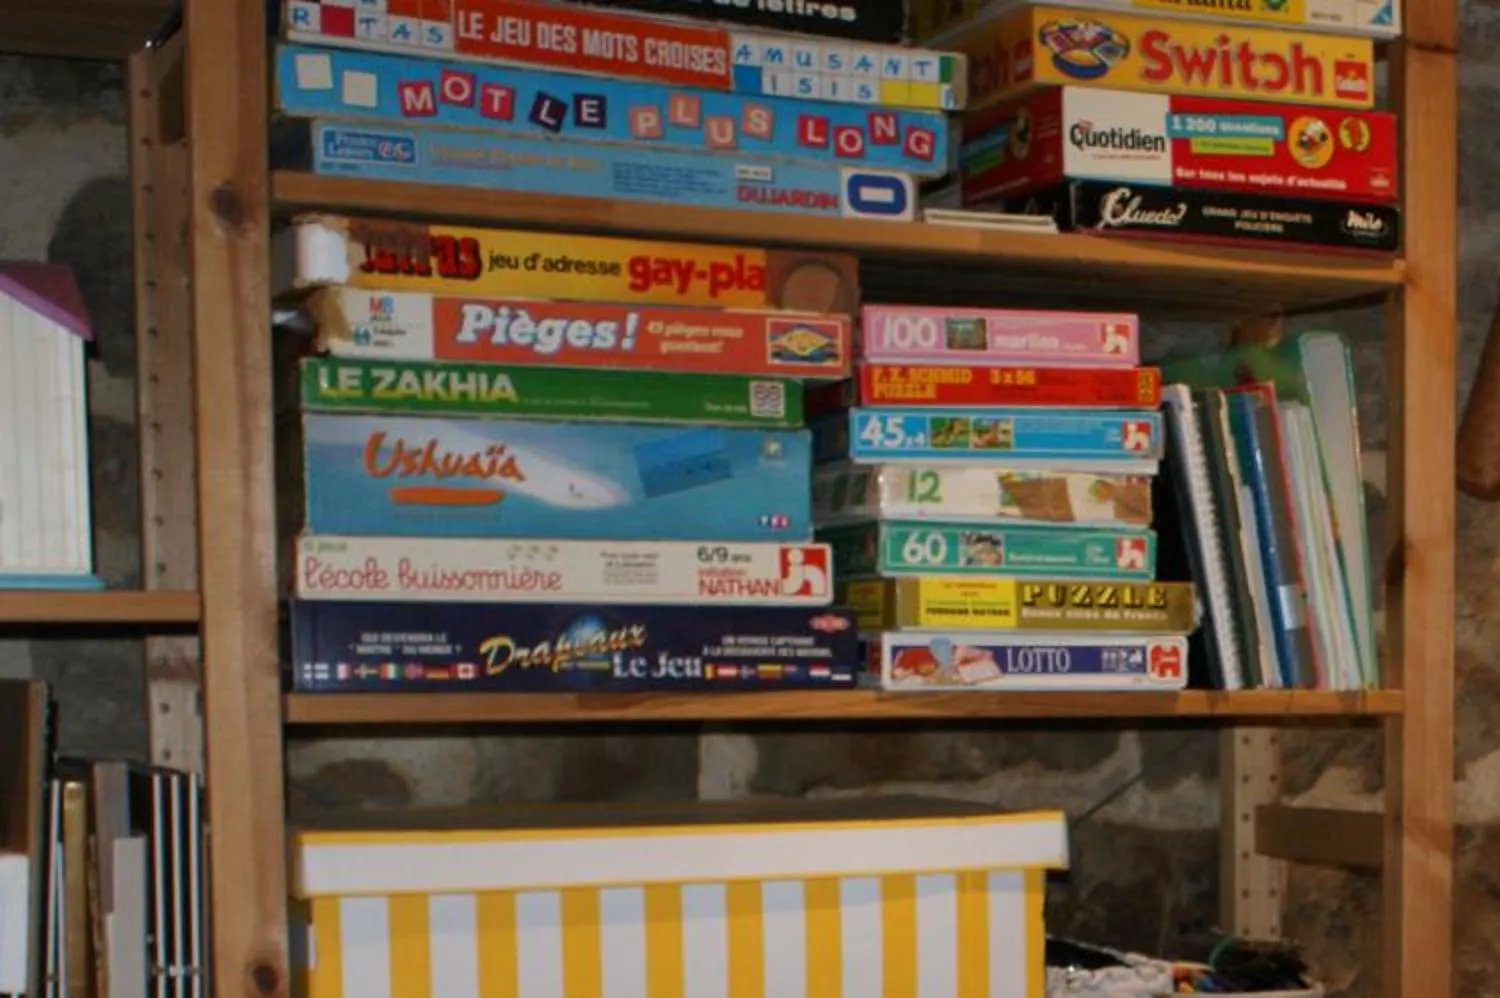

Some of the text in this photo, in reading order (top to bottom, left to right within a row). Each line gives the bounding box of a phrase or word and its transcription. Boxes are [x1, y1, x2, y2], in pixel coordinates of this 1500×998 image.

[458, 10, 727, 77] LE JEU DES MOTS CROISES
[1138, 29, 1325, 97] Switch
[404, 77, 932, 157] MOT LE PLUS LONG
[1069, 122, 1166, 154] Quotidien
[488, 252, 519, 272] jeu
[883, 317, 938, 349] 100
[317, 366, 520, 404] LE ZAKHIA
[860, 417, 905, 448] 45
[906, 470, 942, 502] 12
[902, 530, 947, 565] 60
[698, 579, 781, 597] NATHAN
[1022, 584, 1169, 610] PUZZLE
[1006, 647, 1072, 674] LOTTO
